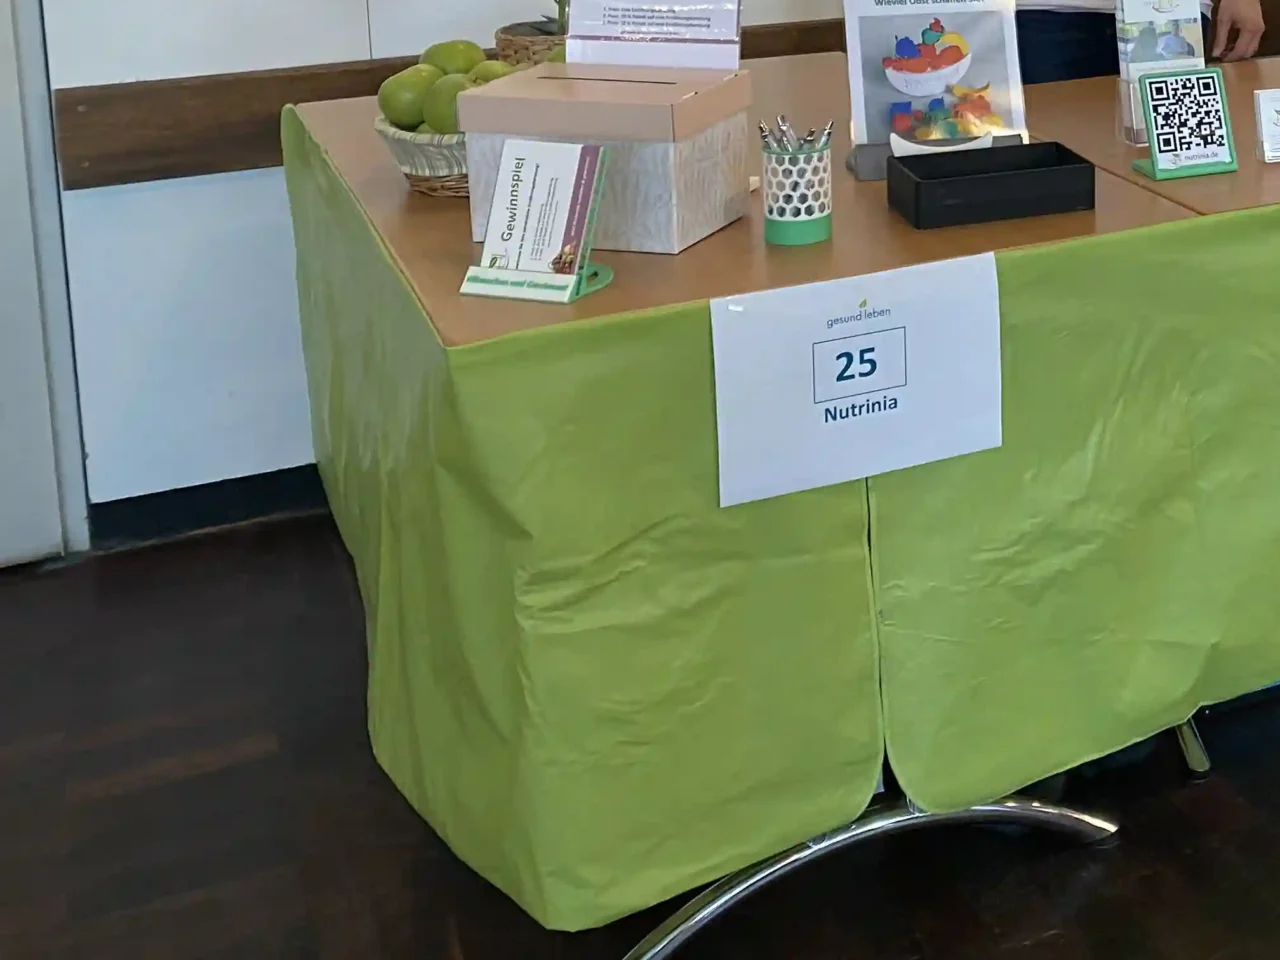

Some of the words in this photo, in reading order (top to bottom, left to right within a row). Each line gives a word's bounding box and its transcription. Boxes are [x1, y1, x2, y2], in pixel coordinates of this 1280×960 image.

[501, 157, 526, 242] Gewinnspiel
[826, 310, 863, 329] gesund
[864, 306, 892, 321] leben
[835, 346, 878, 383] 25
[824, 395, 899, 424] Nutrinia
